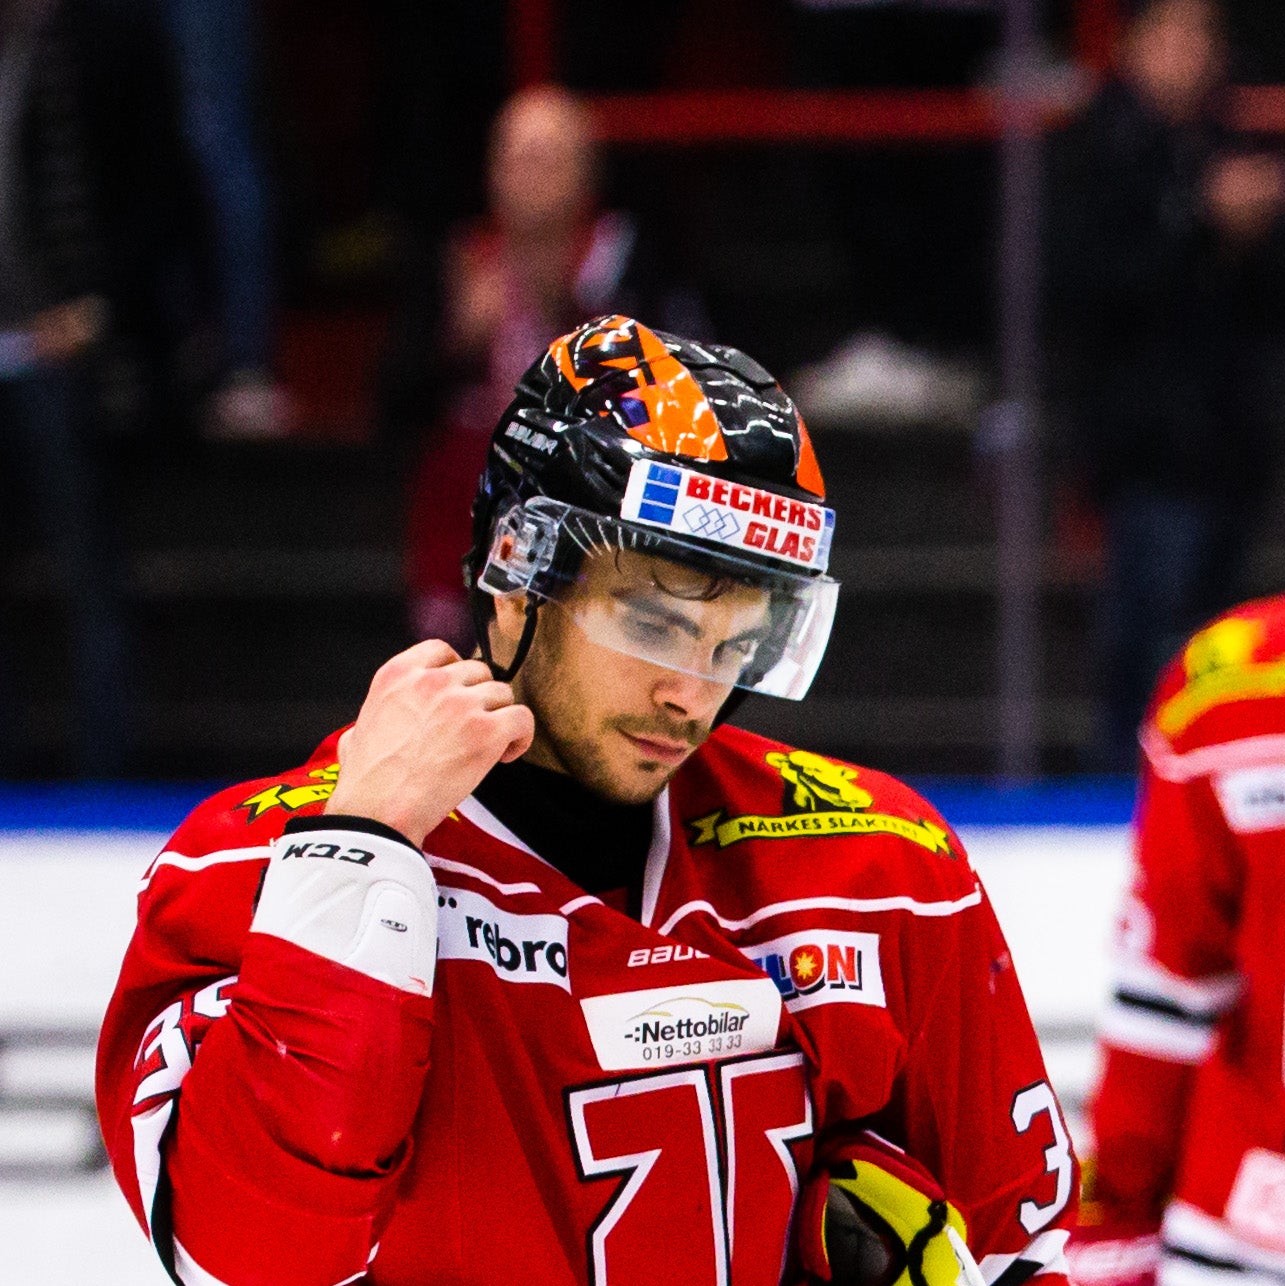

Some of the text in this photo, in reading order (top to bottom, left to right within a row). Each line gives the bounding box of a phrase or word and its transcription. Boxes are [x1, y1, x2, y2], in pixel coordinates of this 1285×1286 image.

[686, 475, 822, 532] BECKERS
[742, 521, 816, 563] GLAS
[642, 1034, 743, 1061] 019-33 33 33
